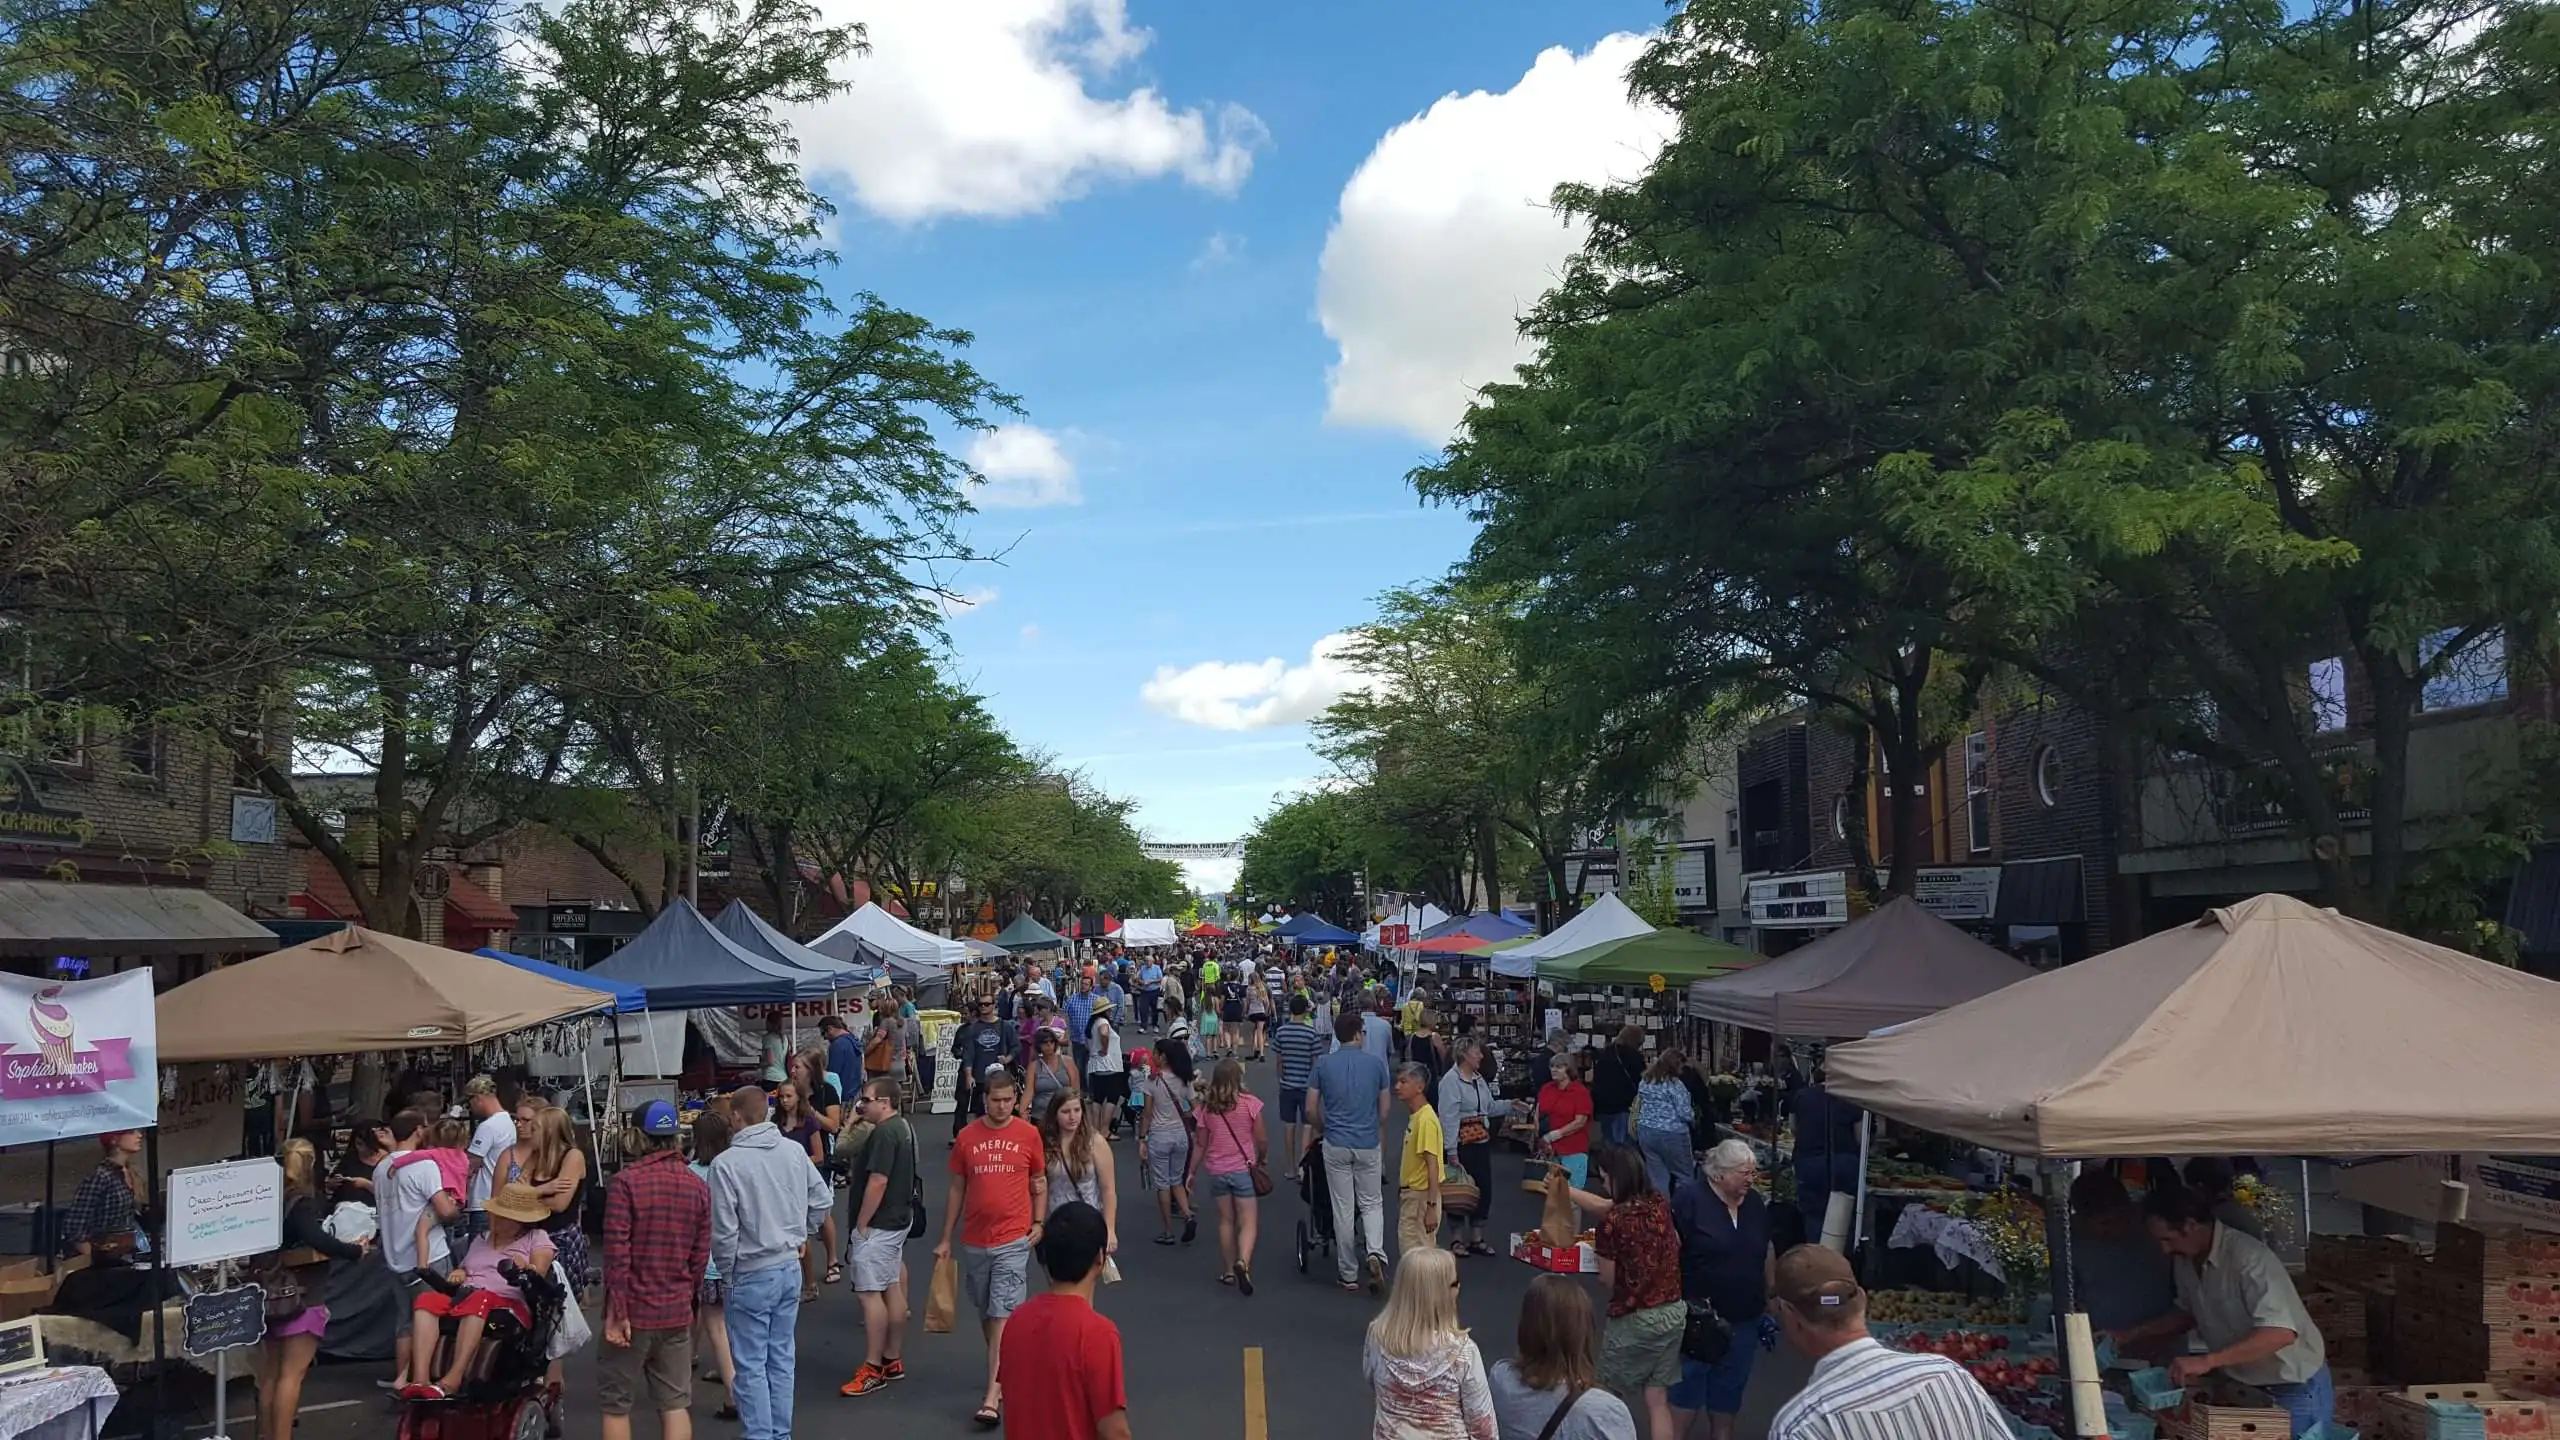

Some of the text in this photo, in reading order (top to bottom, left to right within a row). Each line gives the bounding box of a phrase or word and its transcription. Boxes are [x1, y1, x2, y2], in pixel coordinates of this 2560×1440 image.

[743, 998, 863, 1020] CHERRIES
[973, 1139, 1019, 1156] AMERICA
[988, 1153, 1003, 1162] THE
[974, 1164, 1015, 1174] BEAUTIFUL
